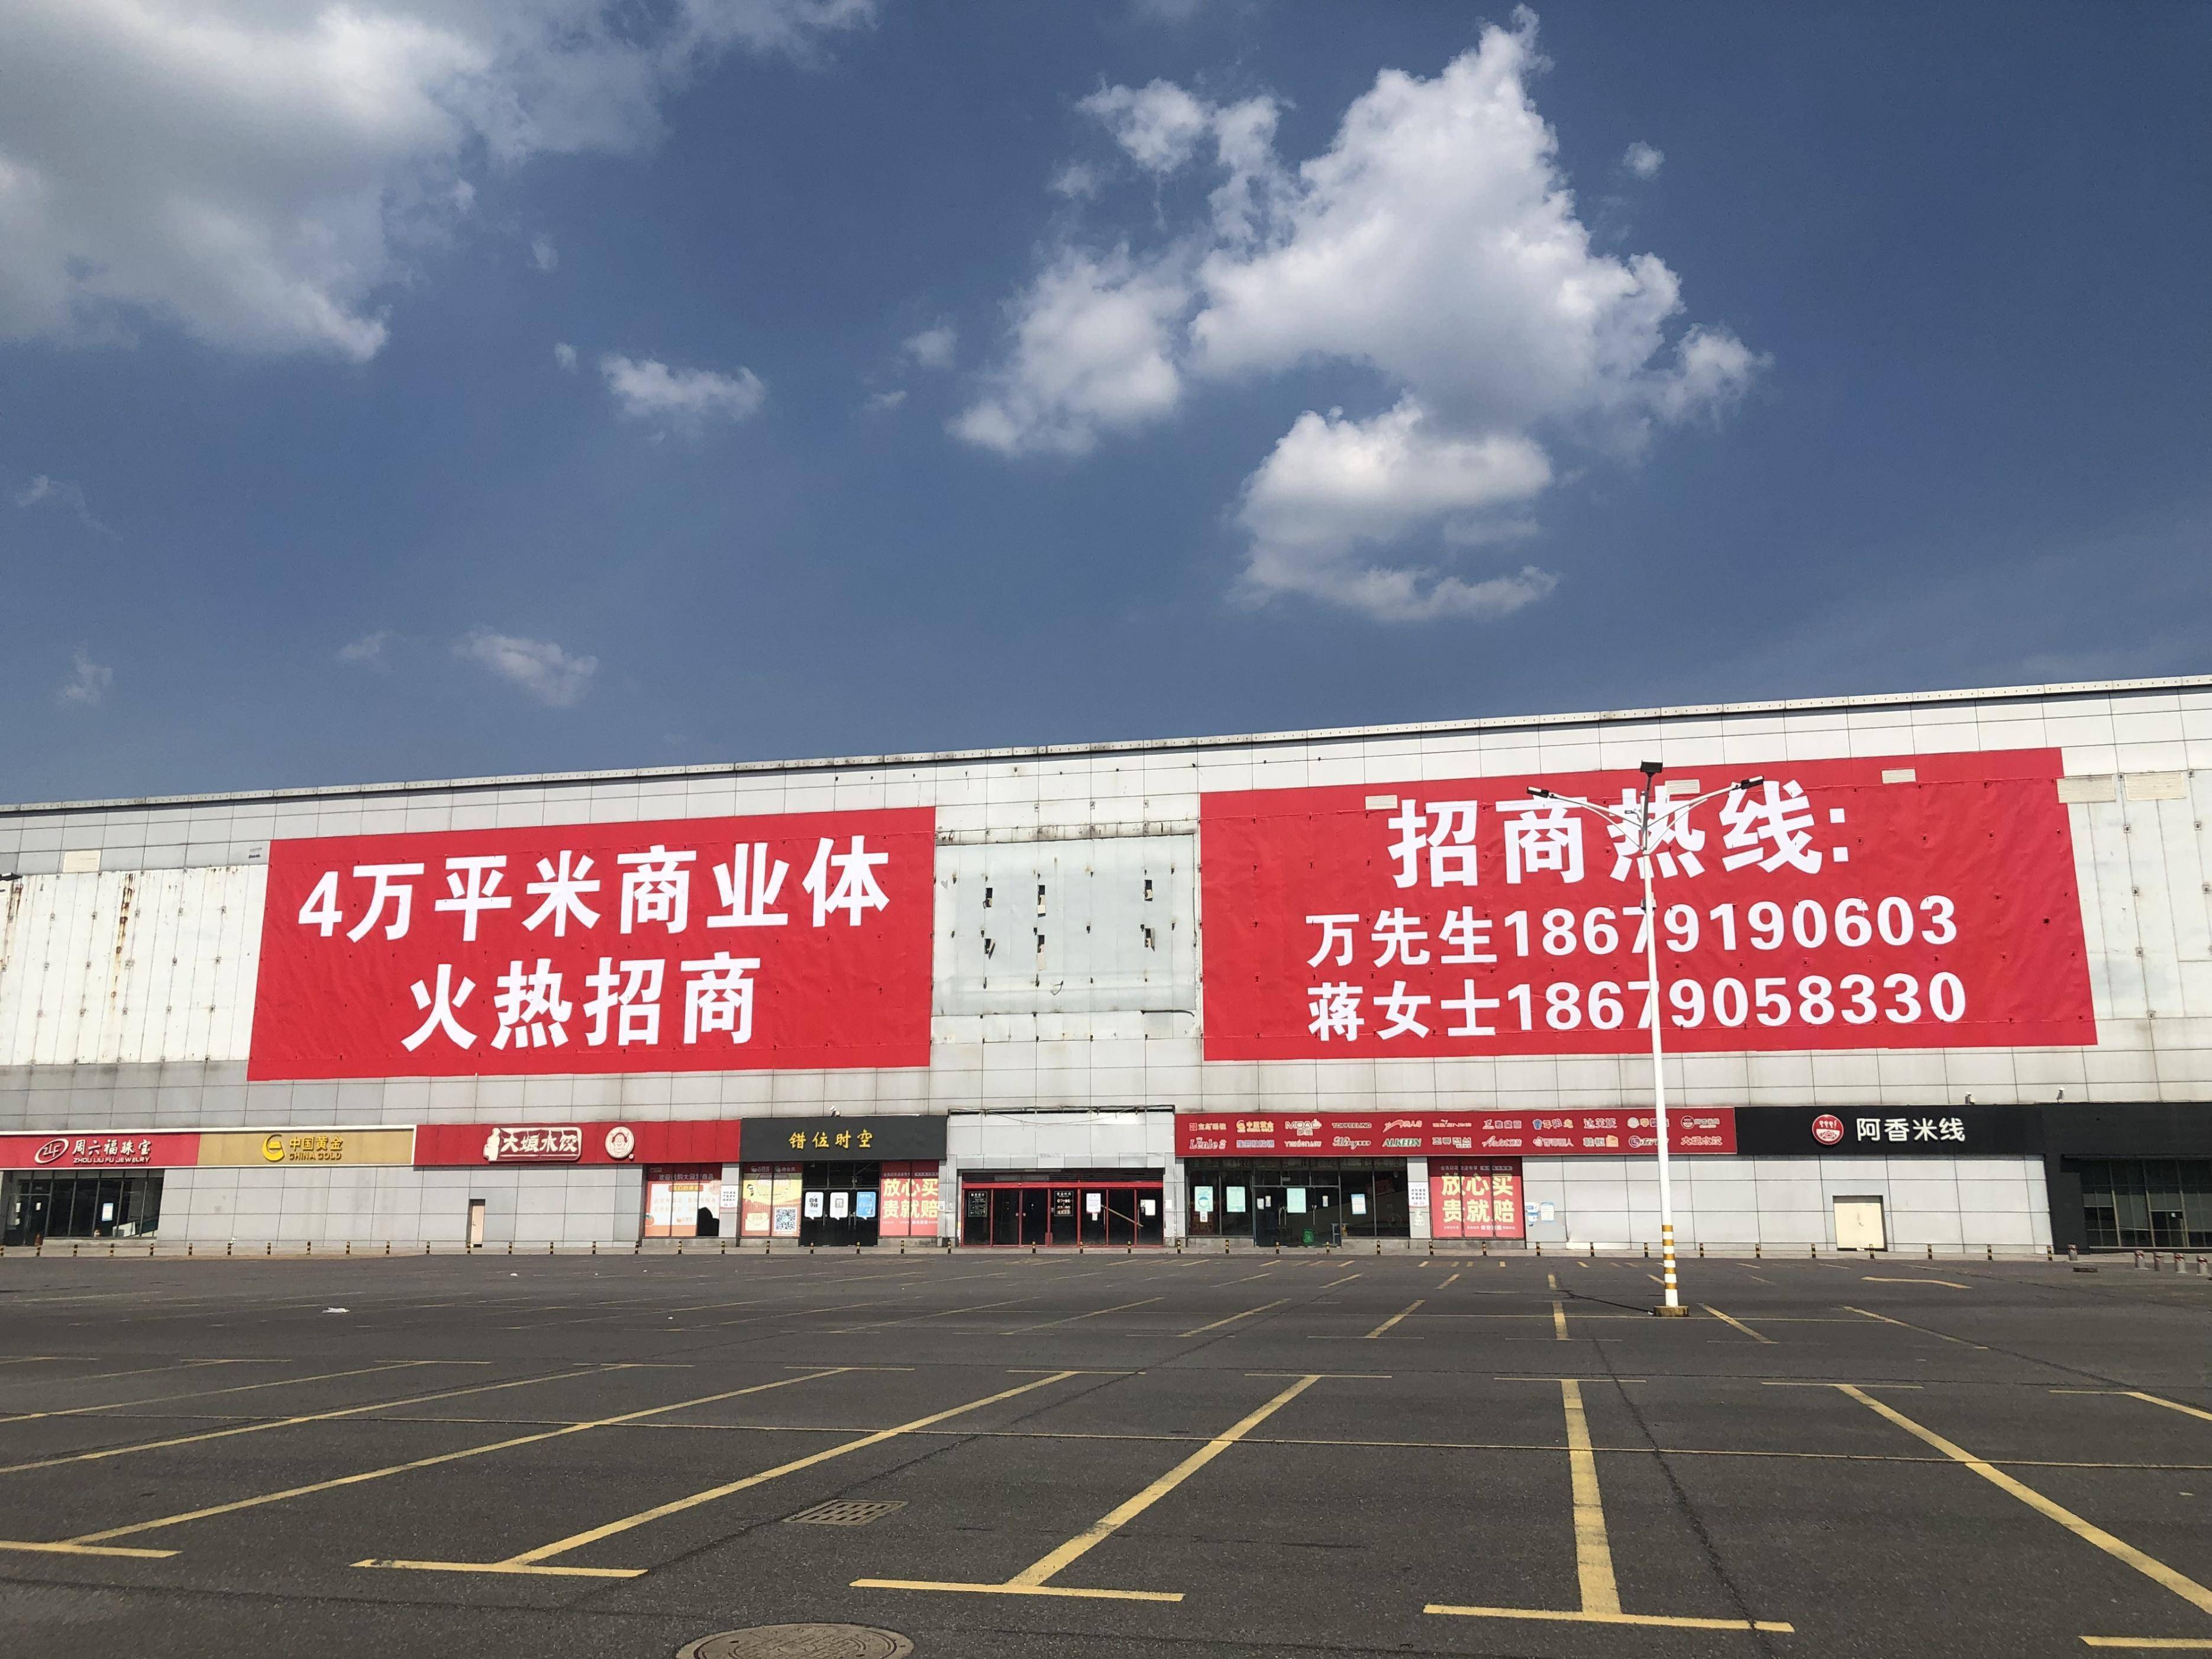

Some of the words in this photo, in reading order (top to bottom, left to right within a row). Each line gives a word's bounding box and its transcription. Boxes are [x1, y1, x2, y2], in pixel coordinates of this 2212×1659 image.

[299, 835, 890, 943] 4万平米商业体
[1306, 895, 1957, 968] 万先生18679190603
[401, 951, 761, 1052] 火热招商
[500, 1130, 579, 1153] 大娘水饺
[789, 1129, 873, 1149] 错位时空
[1856, 1118, 1965, 1142] 阿香米线
[72, 1139, 152, 1157] 周六福珠宝
[289, 1135, 343, 1151] 中国黄金
[289, 1153, 315, 1161] CHINA
[318, 1153, 342, 1161] GOLD
[883, 1178, 938, 1198] 放心买
[1441, 1173, 1513, 1196] 放心买
[882, 1199, 938, 1219] 贵就赔
[1442, 1199, 1515, 1223] 贵就赔
